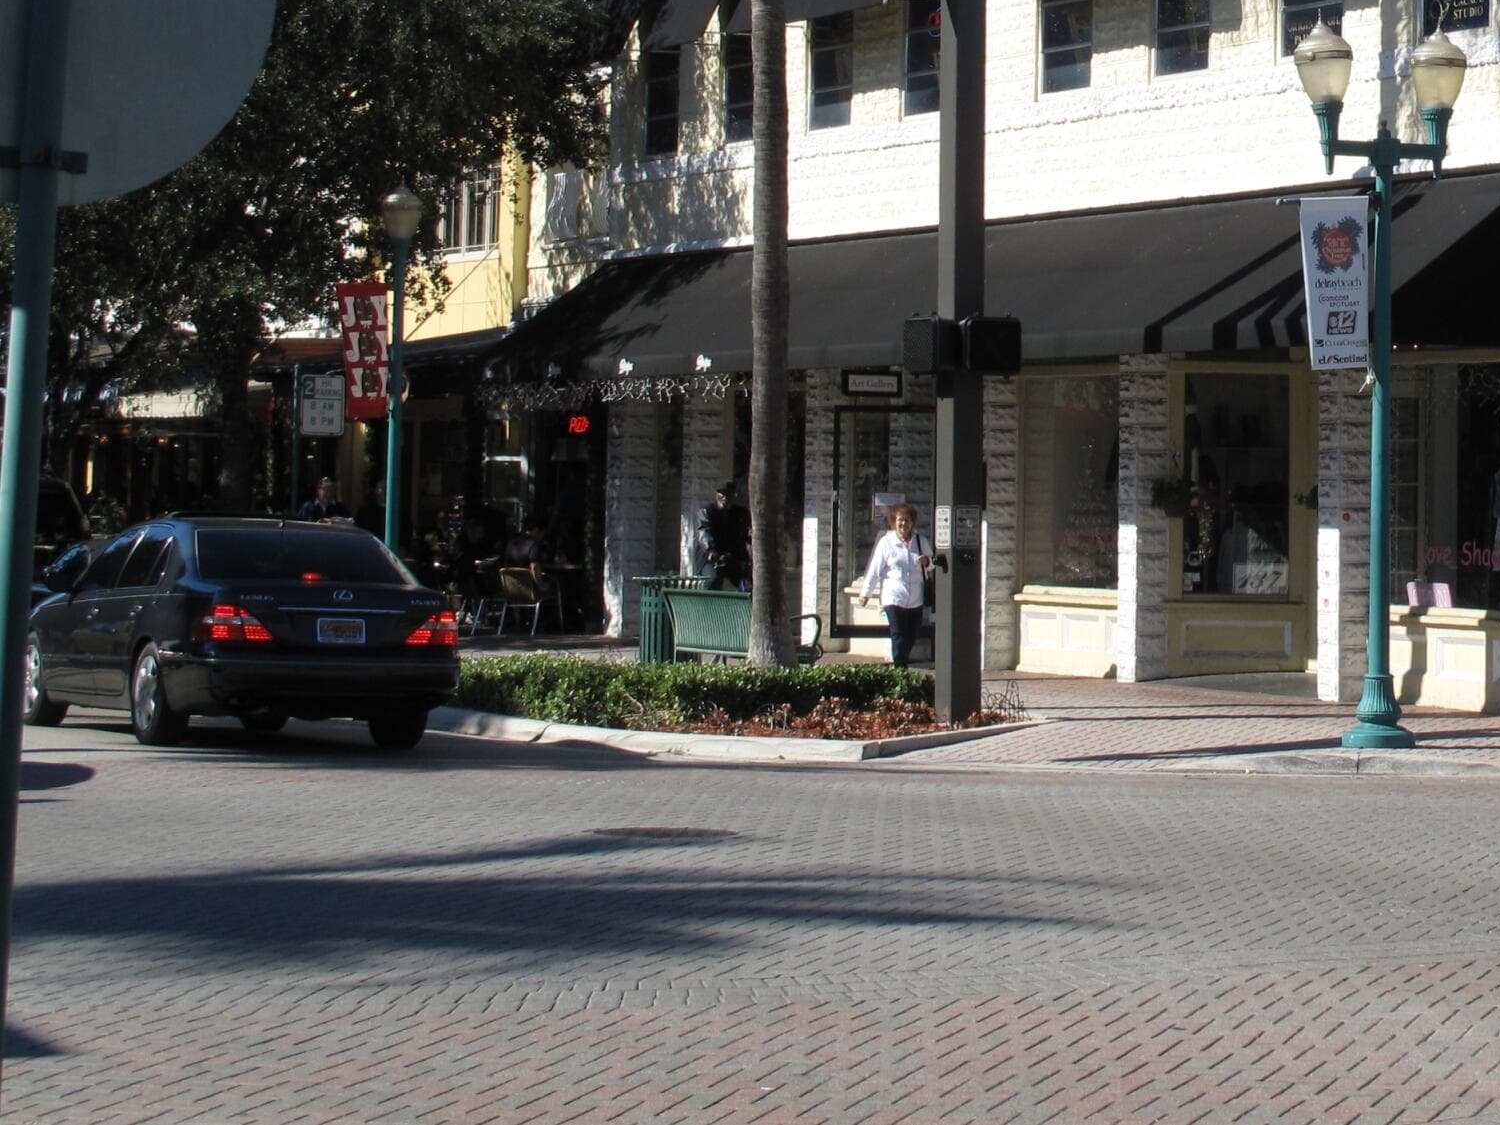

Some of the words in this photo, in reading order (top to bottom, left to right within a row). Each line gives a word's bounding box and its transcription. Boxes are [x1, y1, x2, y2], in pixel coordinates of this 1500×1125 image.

[1453, 6, 1484, 20] STUDIO
[304, 380, 314, 395] 2
[851, 379, 865, 388] Art
[322, 402, 334, 411] AM
[321, 417, 334, 426] PM
